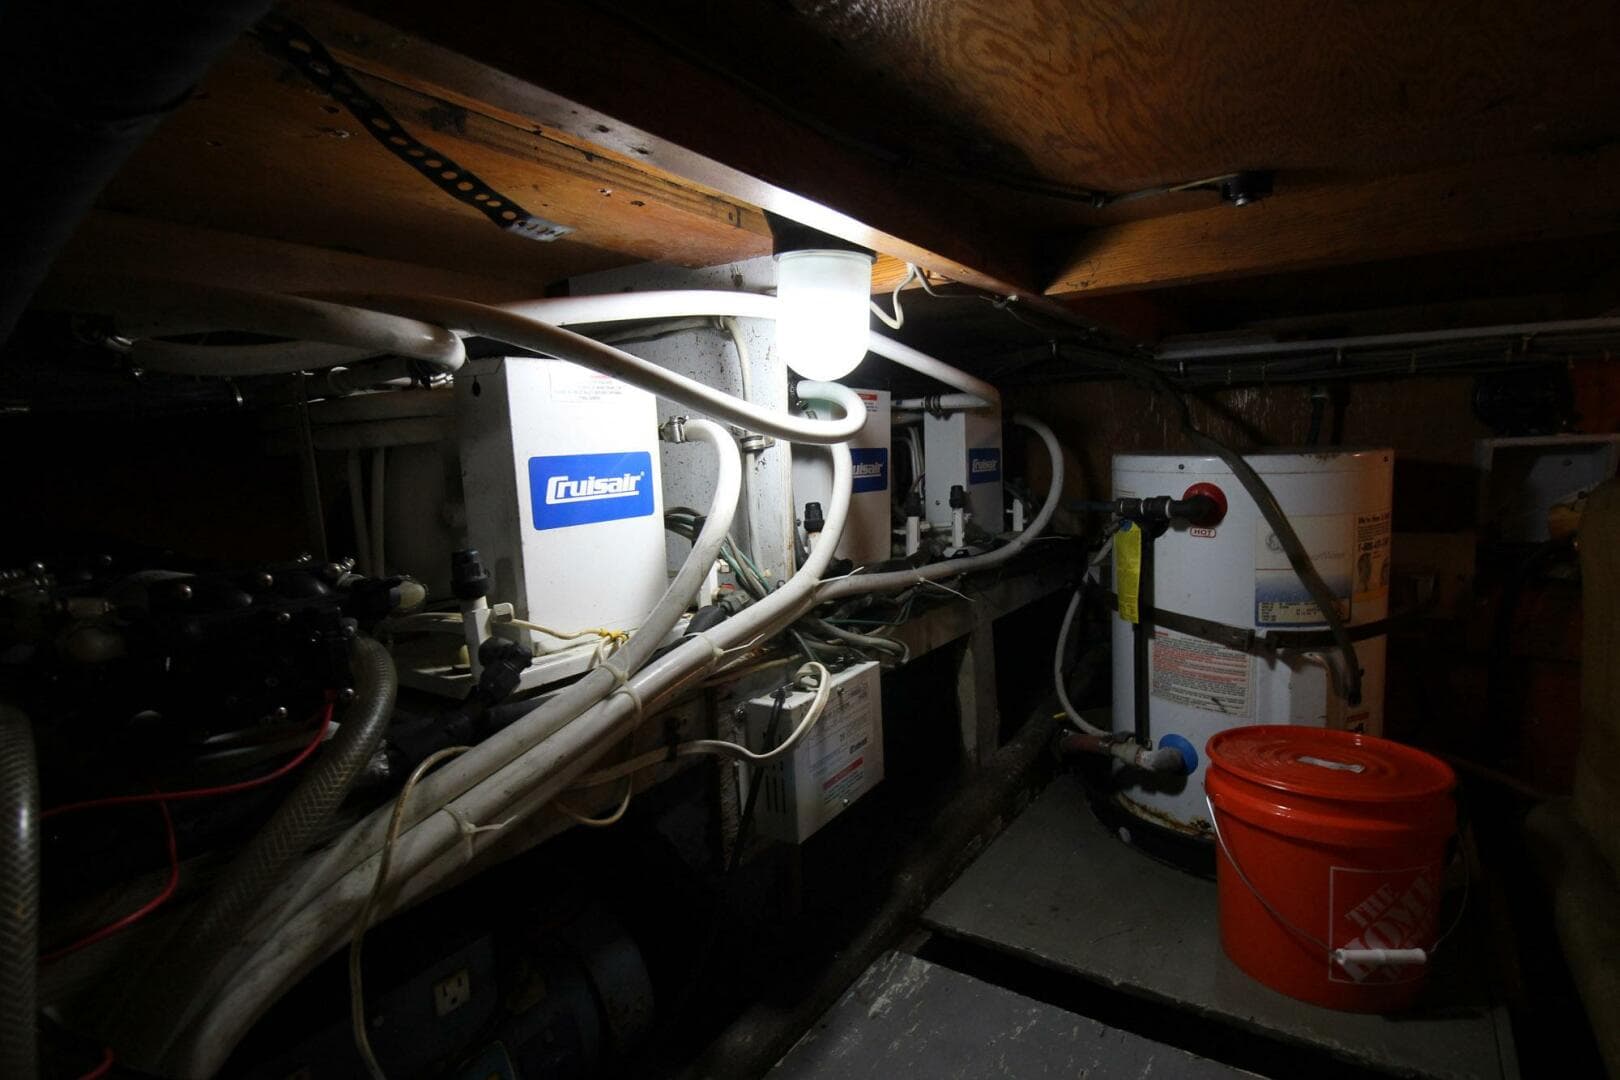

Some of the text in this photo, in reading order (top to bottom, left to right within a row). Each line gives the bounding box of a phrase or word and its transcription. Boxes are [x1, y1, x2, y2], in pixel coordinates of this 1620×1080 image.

[851, 461, 883, 478] uisair
[546, 473, 641, 505] Cruisair
[1344, 882, 1400, 928] THE
